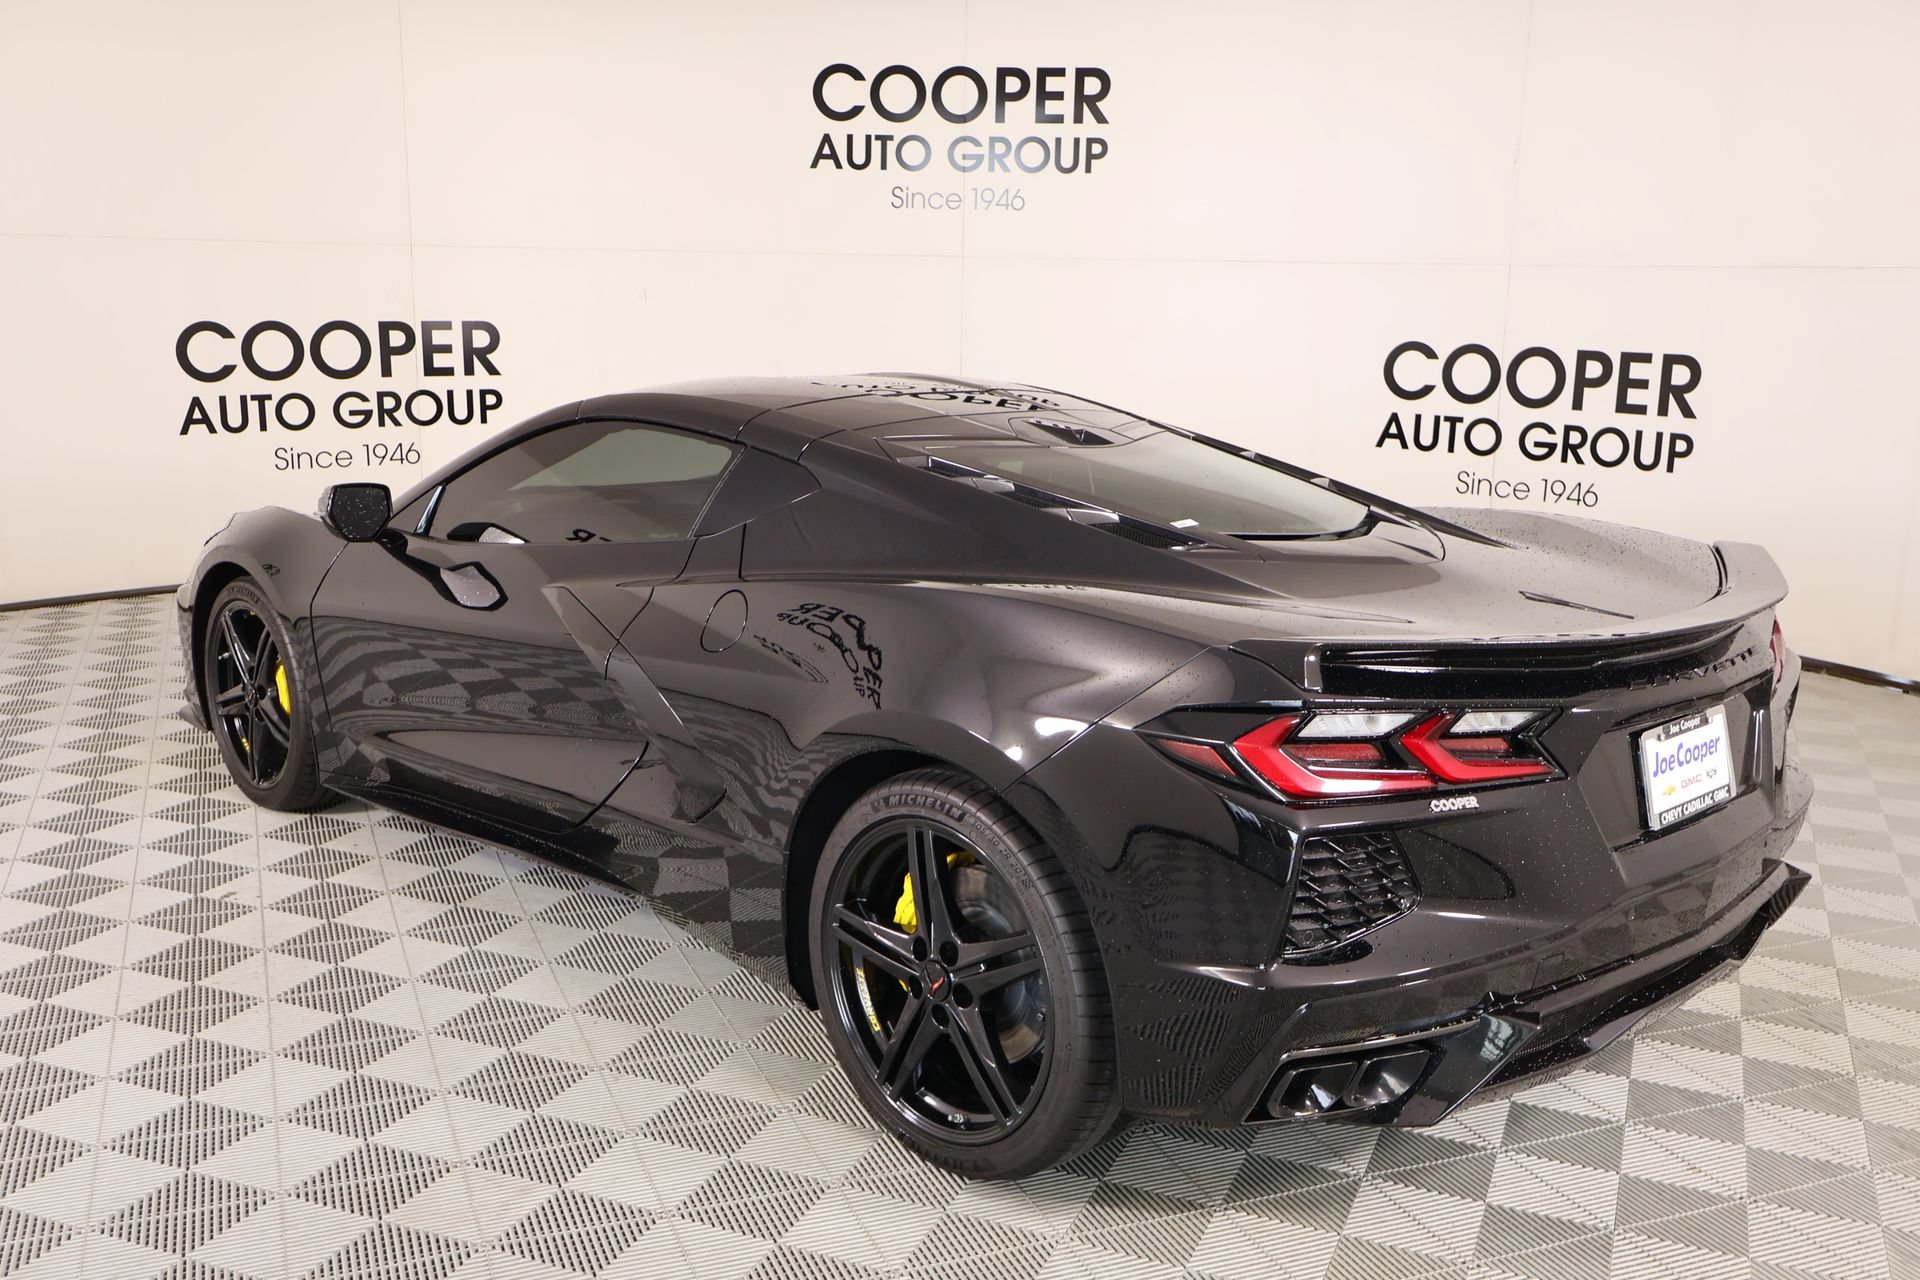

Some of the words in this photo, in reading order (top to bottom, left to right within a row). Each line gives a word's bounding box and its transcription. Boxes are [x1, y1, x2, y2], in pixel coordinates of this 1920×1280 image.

[813, 63, 1112, 125] COOPER
[810, 133, 932, 172] AUTO
[947, 135, 1109, 175] GROUP
[890, 185, 963, 211] Since
[970, 187, 1026, 212] 1946
[176, 320, 502, 383] COOPER
[1383, 340, 1703, 420] COOPER
[179, 392, 316, 436] AUTO
[332, 388, 504, 430] GROUP
[274, 447, 354, 471] Since
[362, 442, 422, 467] 1946
[1375, 411, 1503, 457] AUTO
[1518, 421, 1695, 474] GROUP
[1455, 470, 1531, 501] Since
[1540, 478, 1599, 508] 1946
[1669, 723, 1680, 735] Joe
[1680, 716, 1701, 731] Cooper
[1681, 773, 1703, 789] GMC
[888, 793, 963, 821] MICHELIN
[1430, 796, 1480, 813] COOPER
[1660, 804, 1683, 825] CHEVY
[1682, 792, 1714, 816] CADILLAC
[1713, 785, 1730, 802] GMC
